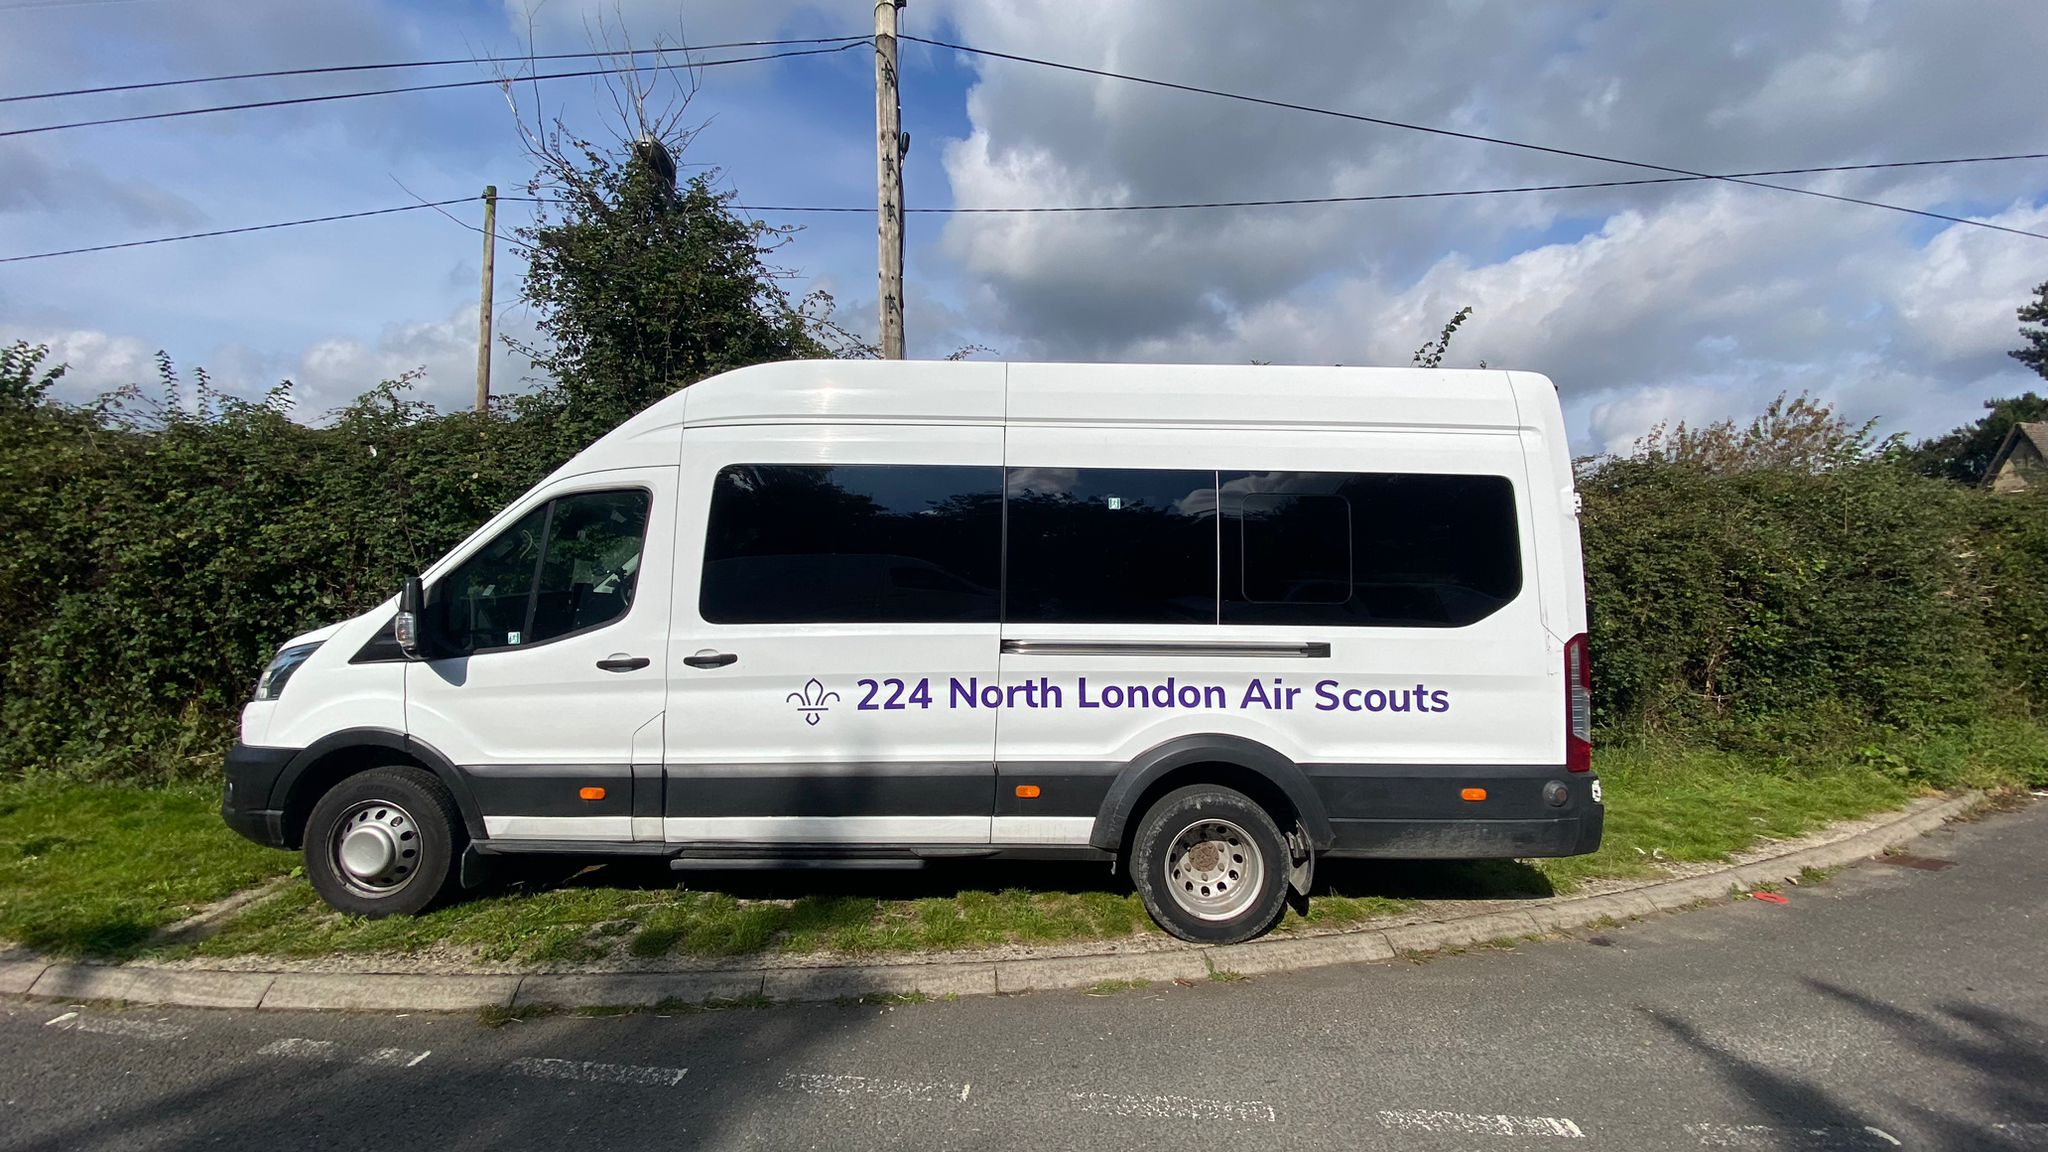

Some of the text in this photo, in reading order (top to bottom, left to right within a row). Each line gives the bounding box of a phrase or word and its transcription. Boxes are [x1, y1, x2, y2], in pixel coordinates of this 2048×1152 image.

[857, 677, 1449, 713] 224 North London Air Scouts
